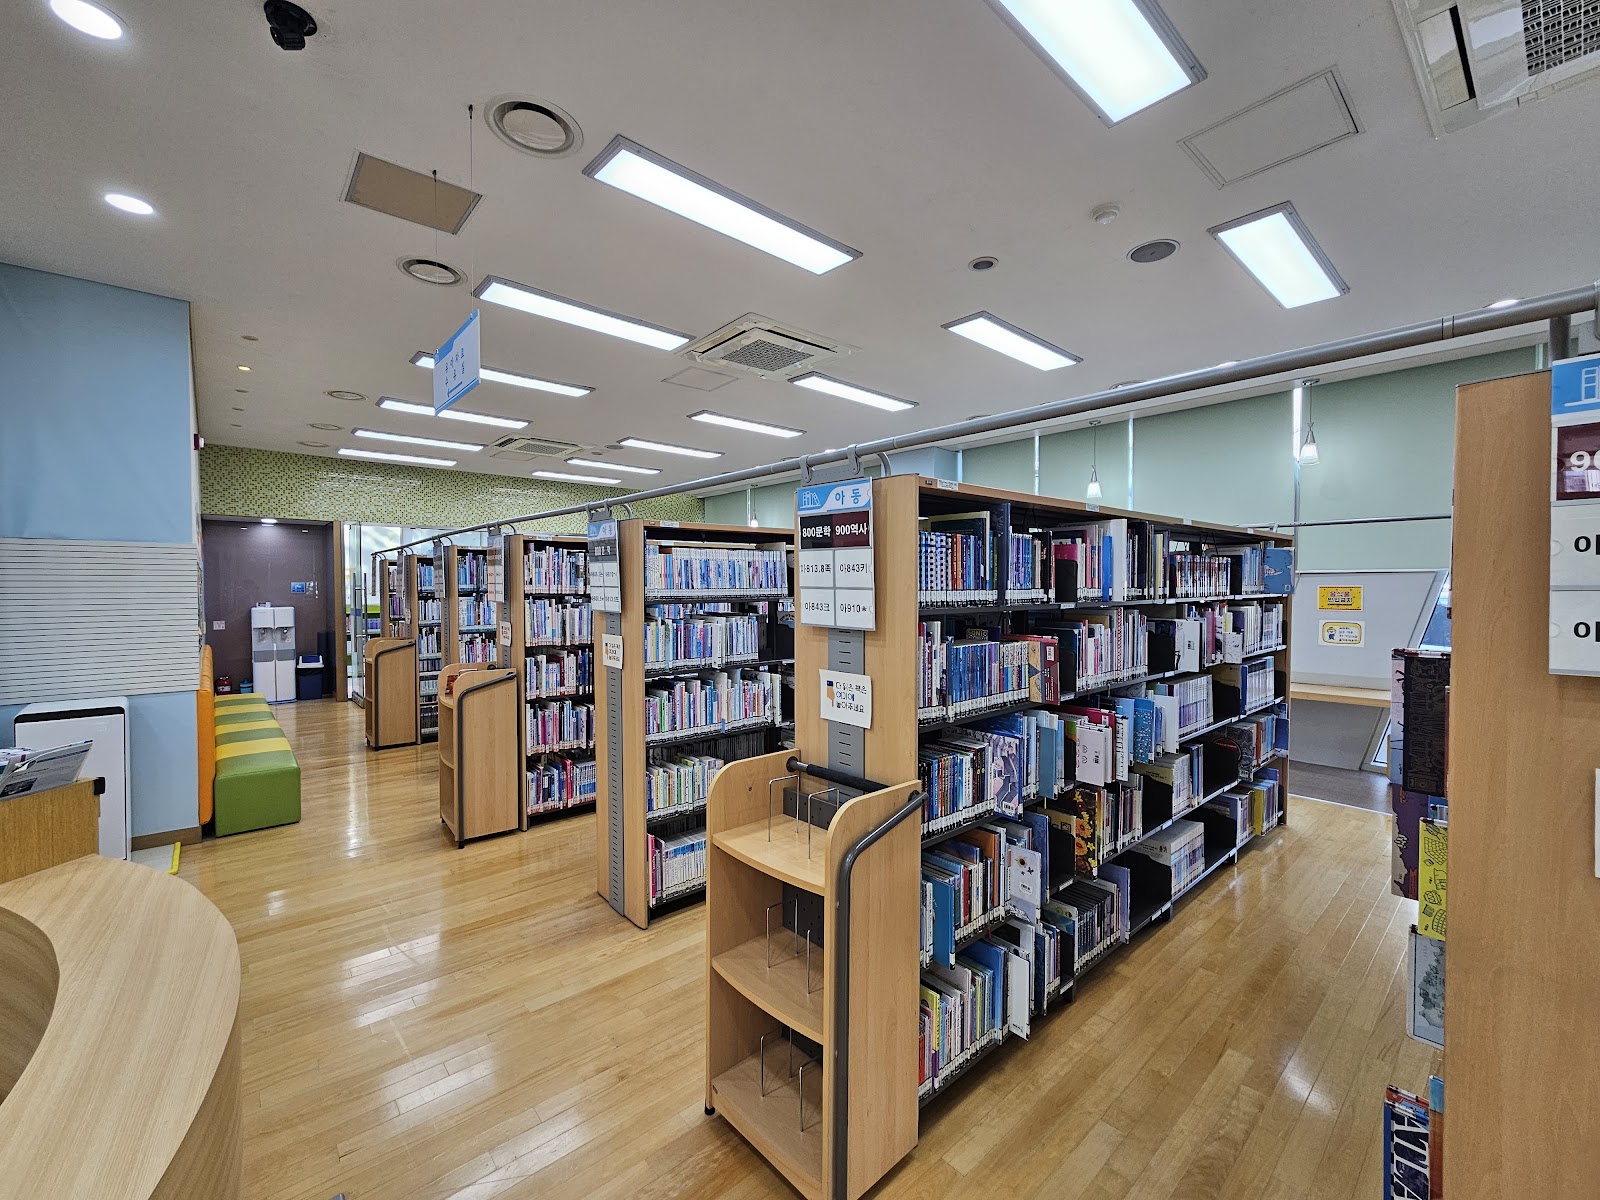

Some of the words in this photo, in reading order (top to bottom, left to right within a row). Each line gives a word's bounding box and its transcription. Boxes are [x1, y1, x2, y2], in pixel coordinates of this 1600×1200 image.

[802, 525, 831, 538] 800문학
[835, 522, 868, 536] 900역사
[839, 563, 868, 574] 아843키
